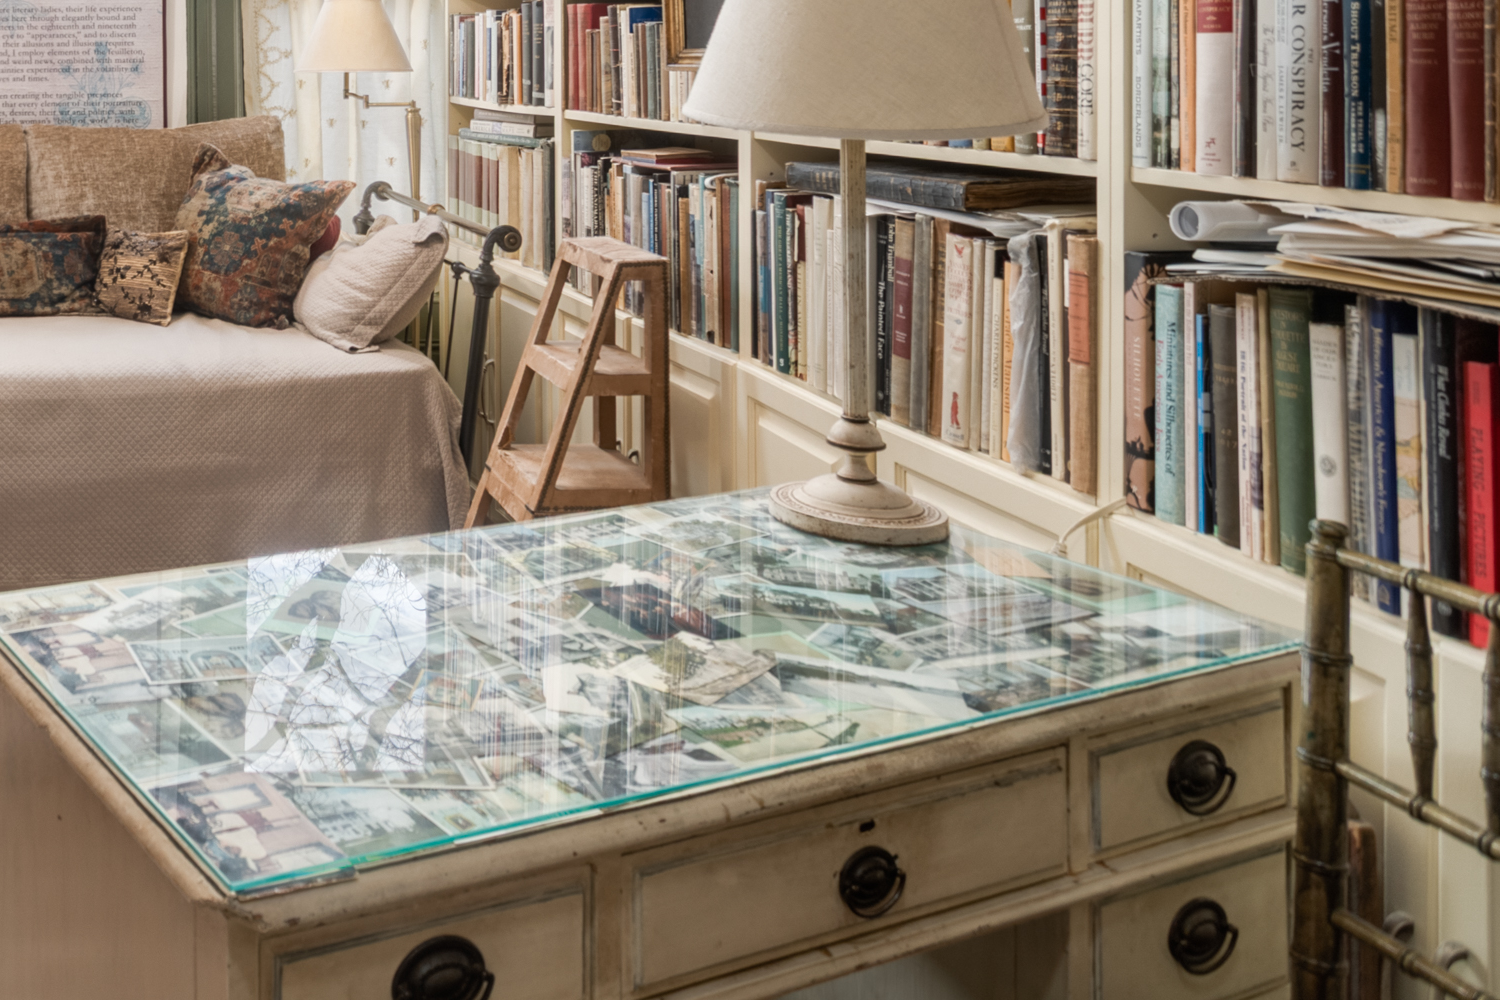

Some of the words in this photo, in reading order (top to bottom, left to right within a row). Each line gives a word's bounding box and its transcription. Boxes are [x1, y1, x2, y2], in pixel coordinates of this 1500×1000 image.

[1350, 1, 1360, 40] SHOUT
[1290, 25, 1306, 152] CONSPIRACY
[1322, 41, 1340, 93] Vendetta
[1350, 43, 1360, 97] TREASON
[1358, 143, 1364, 154] OF
[887, 244, 895, 282] Trumbull
[877, 300, 885, 335] Painted
[1155, 339, 1164, 371] Early
[1165, 321, 1176, 379] Miniatures
[1370, 326, 1384, 378] Jefferson's
[1132, 336, 1142, 421] SILHOUETTE
[1155, 372, 1164, 424] American
[1165, 382, 1175, 402] and
[1374, 380, 1384, 424] America
[1155, 427, 1164, 452] Jews
[1164, 404, 1176, 461] Silhouettes
[1374, 426, 1384, 438] &
[1164, 463, 1175, 477] of
[1471, 426, 1485, 491] PLAYING
[1378, 499, 1387, 535] France
[1474, 512, 1487, 578] PICTURES
